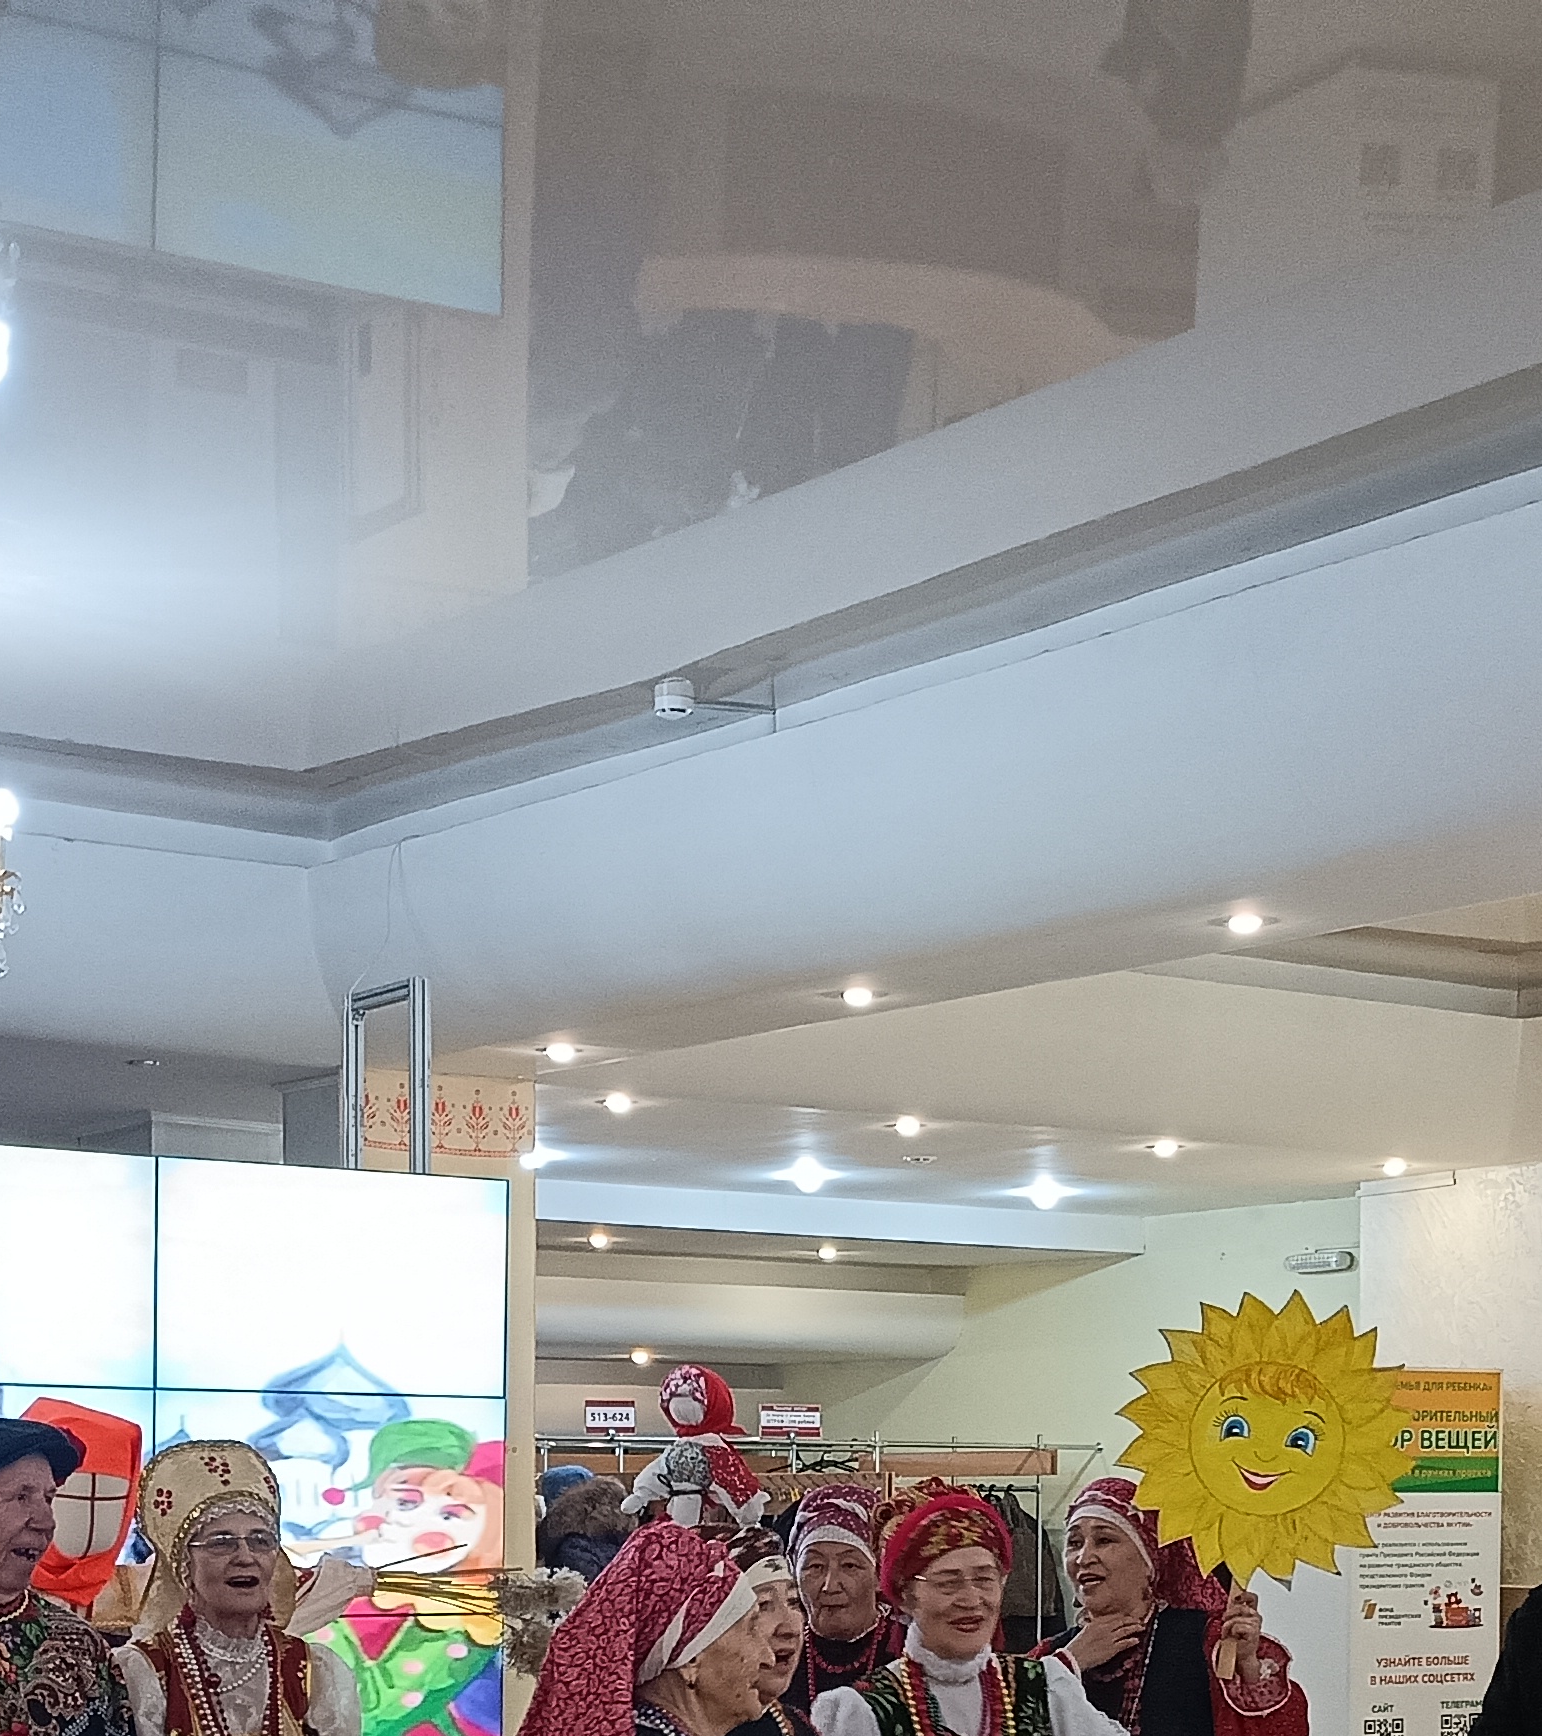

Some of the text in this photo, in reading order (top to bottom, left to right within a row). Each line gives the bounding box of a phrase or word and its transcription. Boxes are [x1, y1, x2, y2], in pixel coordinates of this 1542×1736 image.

[1422, 1381, 1444, 1393] ДЛЯ
[590, 1412, 630, 1421] 513-624
[1412, 1408, 1499, 1423] ОРИТЕЛЬНЫЙ
[1420, 1424, 1498, 1455] ВЕЩЕЙ
[1376, 1654, 1470, 1668] УЗНАЙТЕ БОЛЬШЕ
[1370, 1672, 1476, 1686] В НАШИХ СОЦСЕТЯХ
[1371, 1703, 1394, 1713] САЙТ
